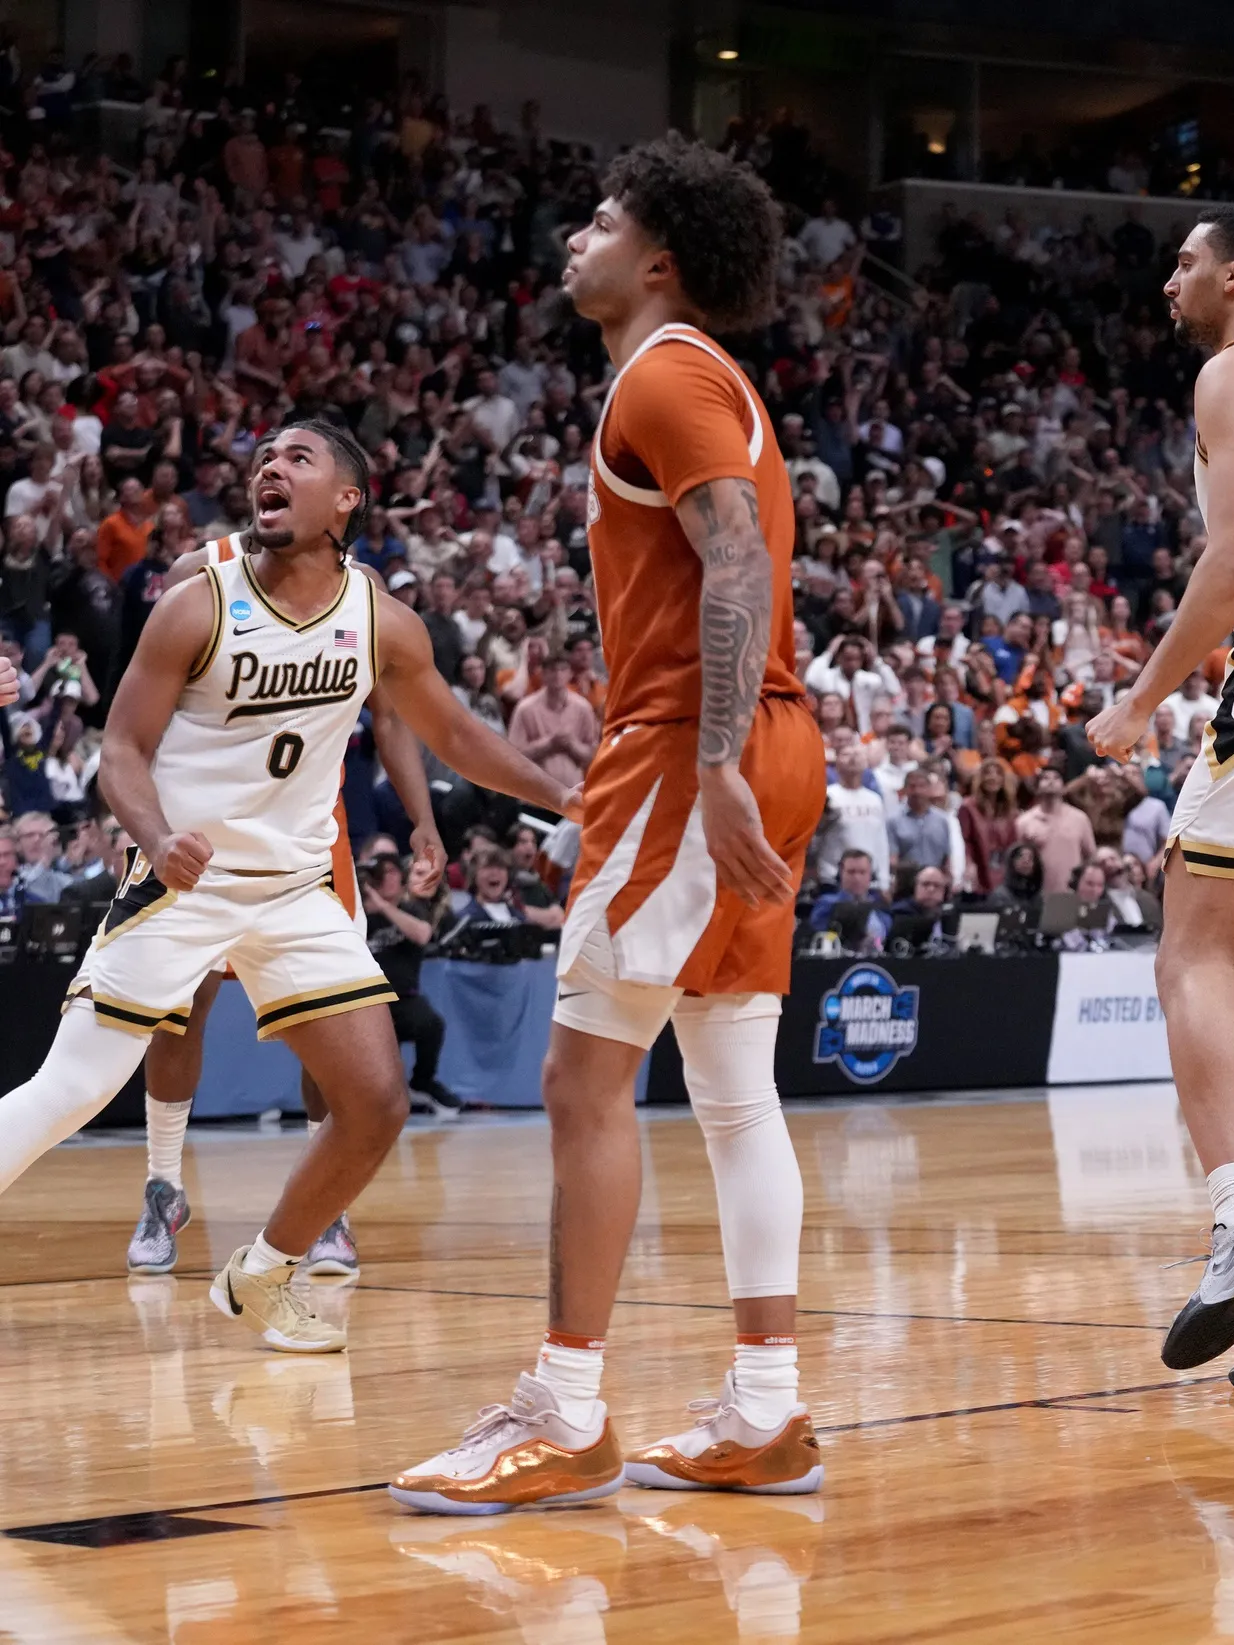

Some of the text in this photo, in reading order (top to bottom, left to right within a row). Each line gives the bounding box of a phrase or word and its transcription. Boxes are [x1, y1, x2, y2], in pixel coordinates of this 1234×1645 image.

[225, 650, 358, 705] Purdue
[266, 731, 305, 779] 0
[841, 996, 893, 1020] MARCH
[1079, 996, 1142, 1024] HOSTED
[845, 1019, 916, 1045] MADNESS
